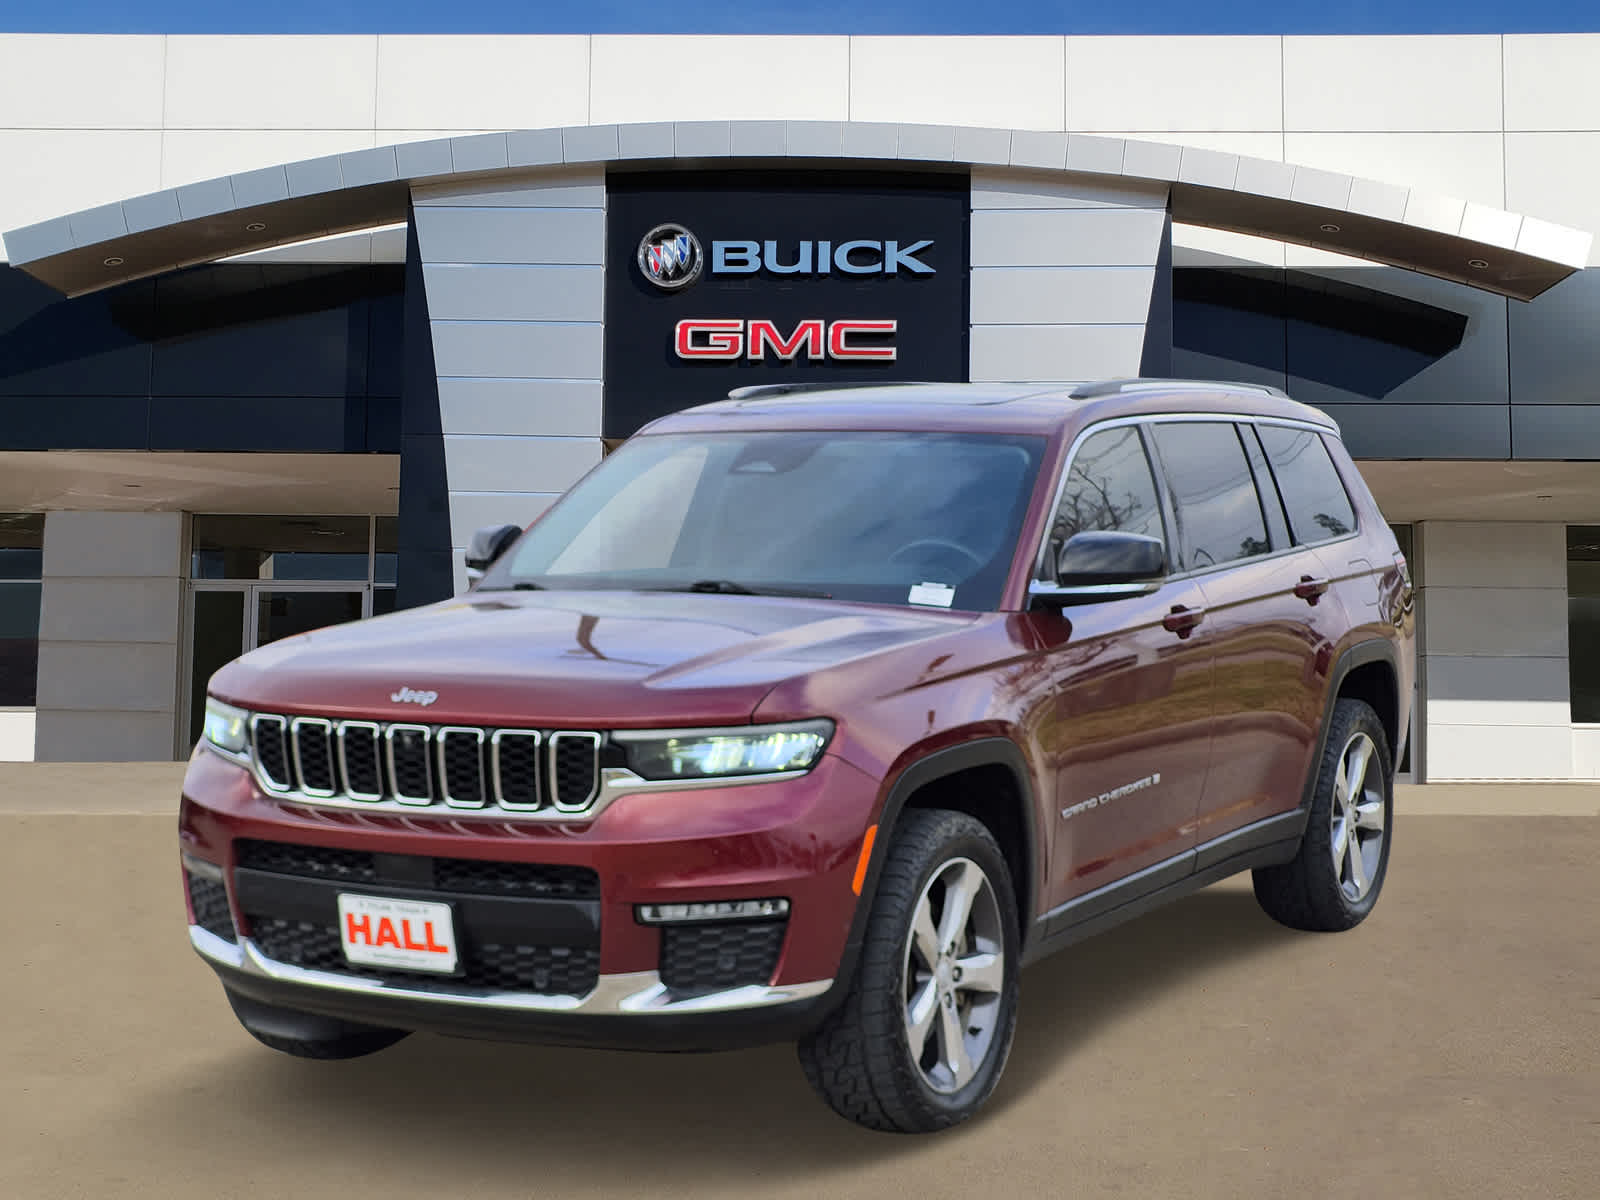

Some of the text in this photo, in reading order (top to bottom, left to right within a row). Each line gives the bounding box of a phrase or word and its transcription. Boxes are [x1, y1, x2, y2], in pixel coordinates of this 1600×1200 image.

[712, 240, 936, 273] BUICK
[675, 319, 897, 360] GMC
[391, 686, 438, 707] Jeep
[346, 912, 449, 954] HALL
